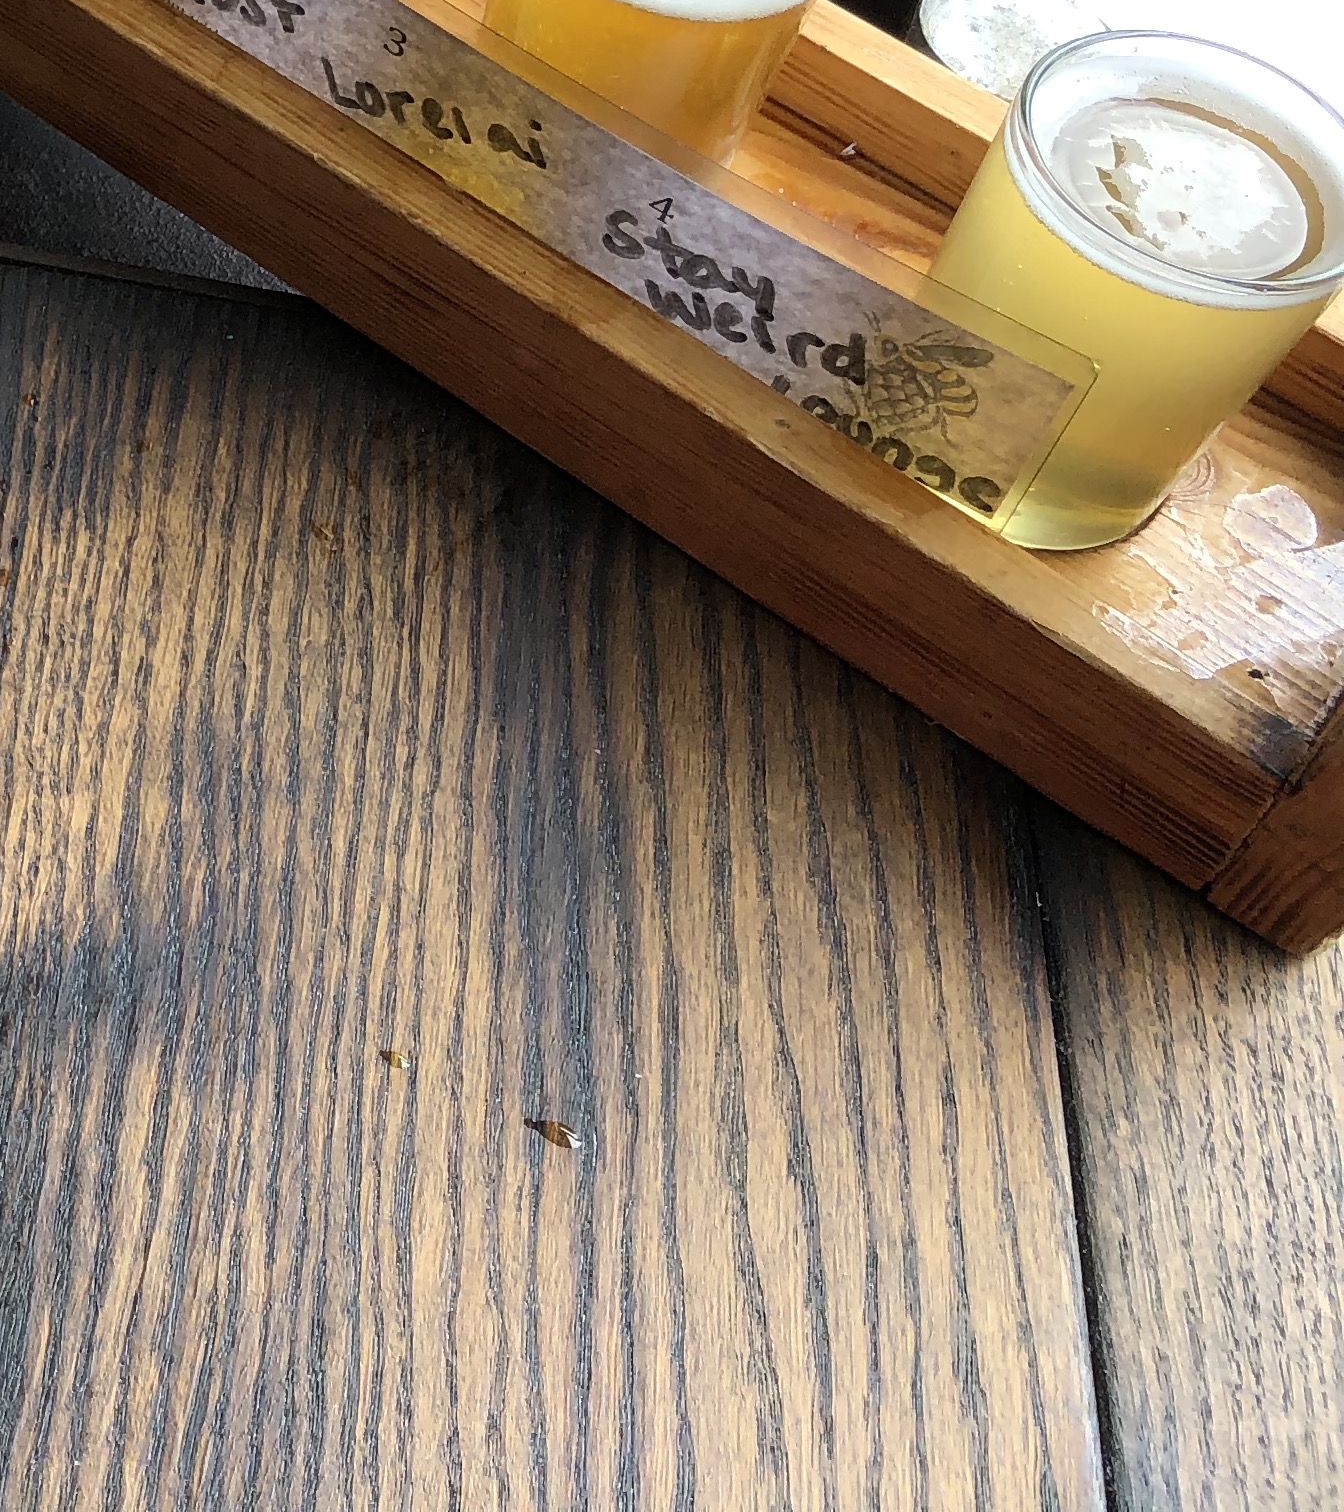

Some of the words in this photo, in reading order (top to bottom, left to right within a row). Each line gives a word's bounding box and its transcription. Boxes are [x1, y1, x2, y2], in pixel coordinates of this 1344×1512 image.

[383, 26, 407, 57] 3
[648, 197, 674, 225] 4
[602, 209, 776, 322] Stay
[772, 374, 1002, 513] ounge
